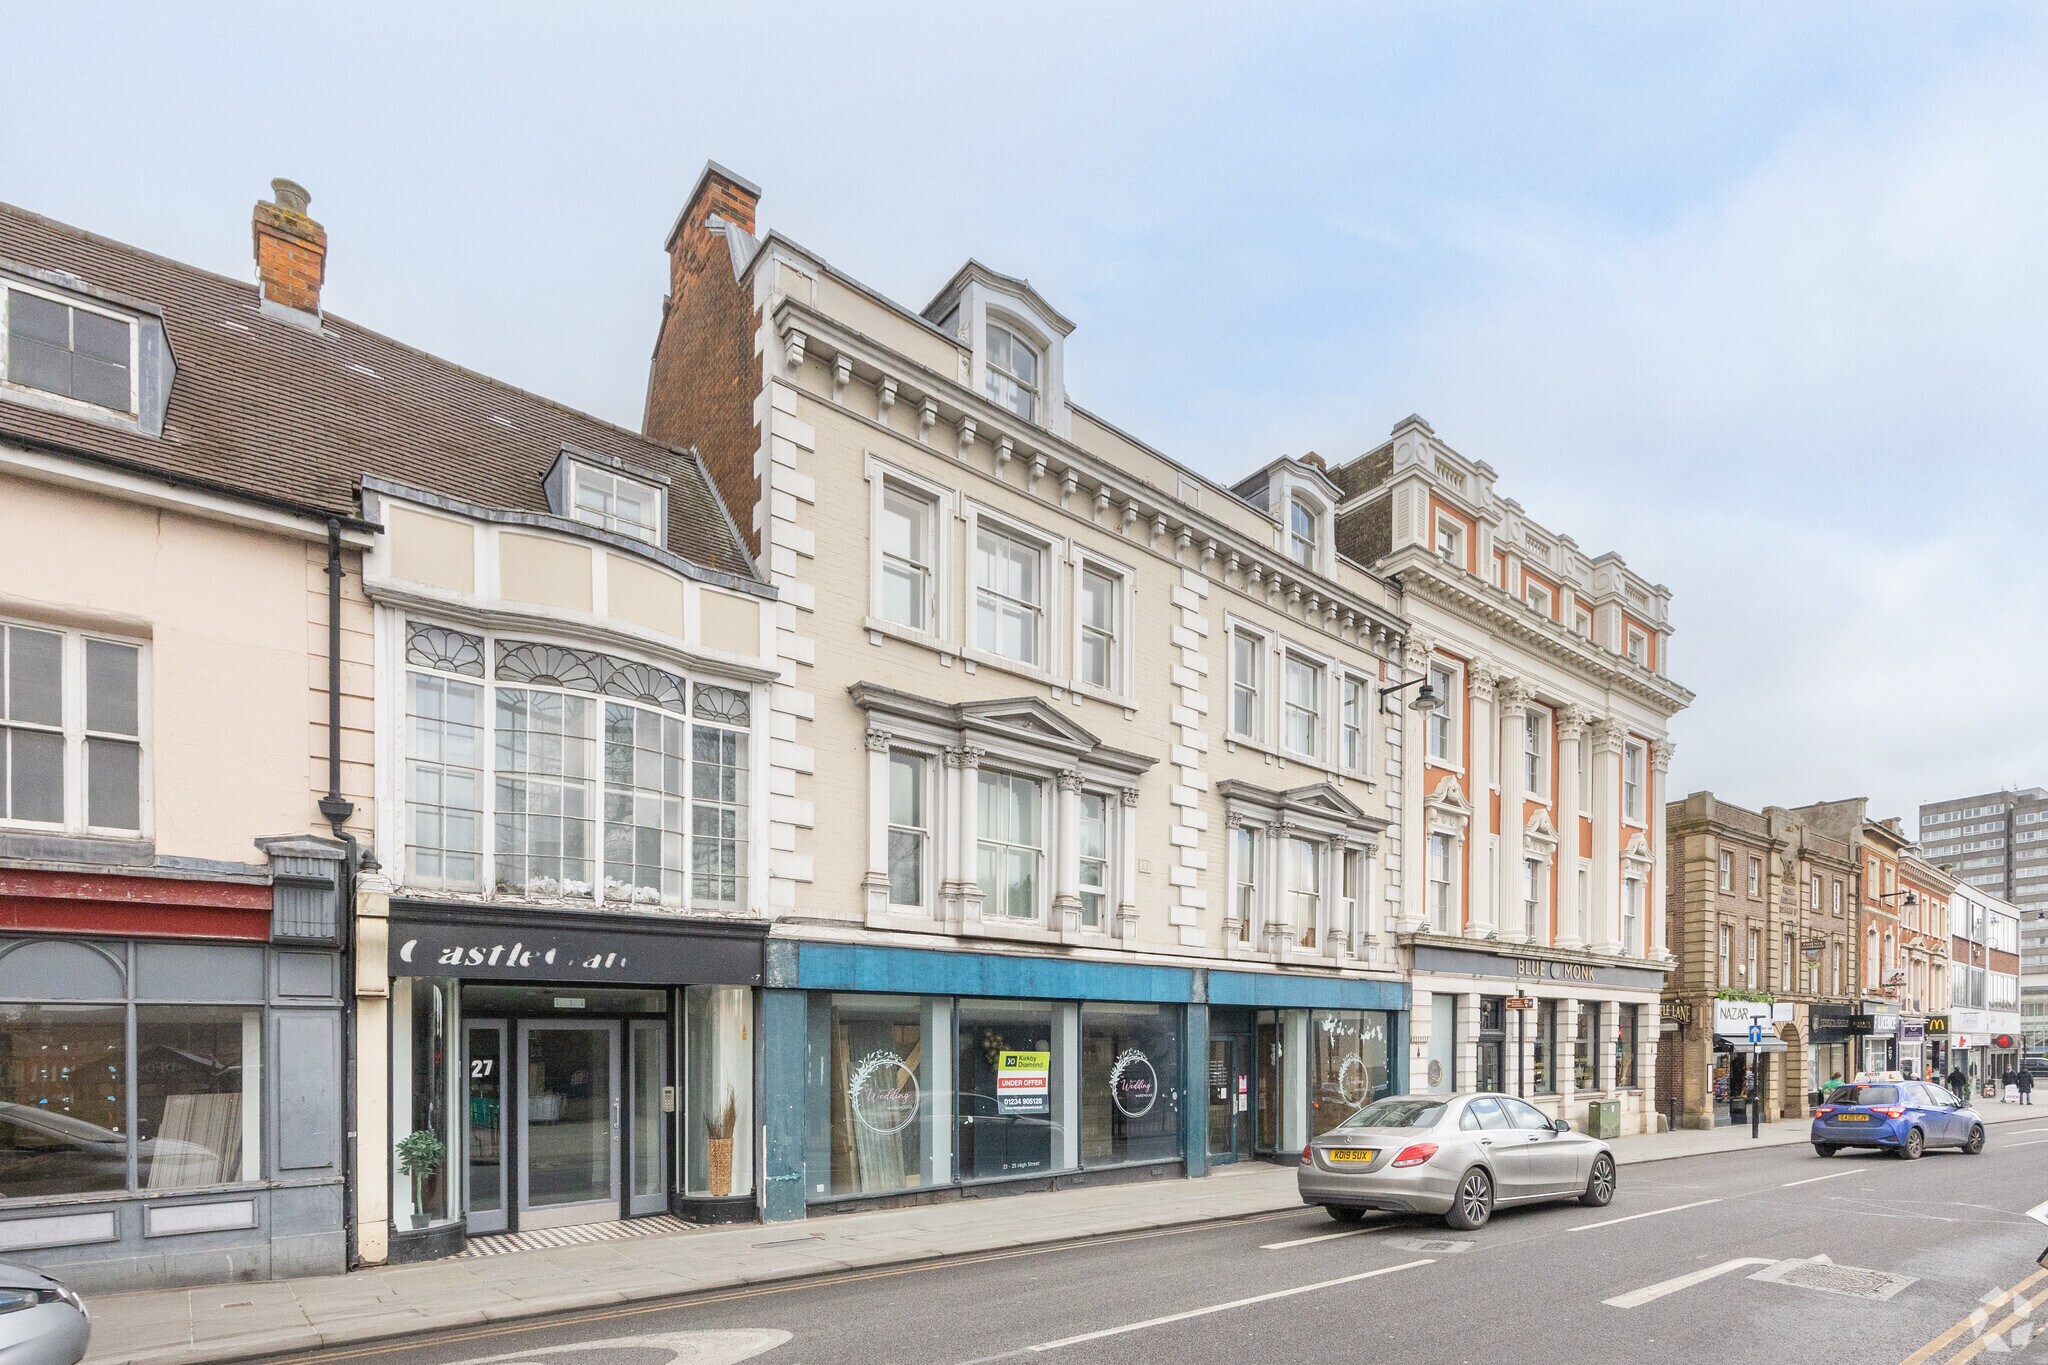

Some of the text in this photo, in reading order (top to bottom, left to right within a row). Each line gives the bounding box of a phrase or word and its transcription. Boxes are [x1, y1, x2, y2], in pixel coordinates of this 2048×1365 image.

[1517, 959, 1595, 980] BLUE MONK
[1672, 1005, 1690, 1022] LANE
[1720, 1008, 1748, 1020] NAZAR
[471, 1060, 493, 1078] 27
[1001, 1079, 1023, 1087] UNDER
[1119, 1079, 1152, 1093] Wedding
[865, 1087, 912, 1104] Wedding
[1352, 1151, 1367, 1159] SUX
